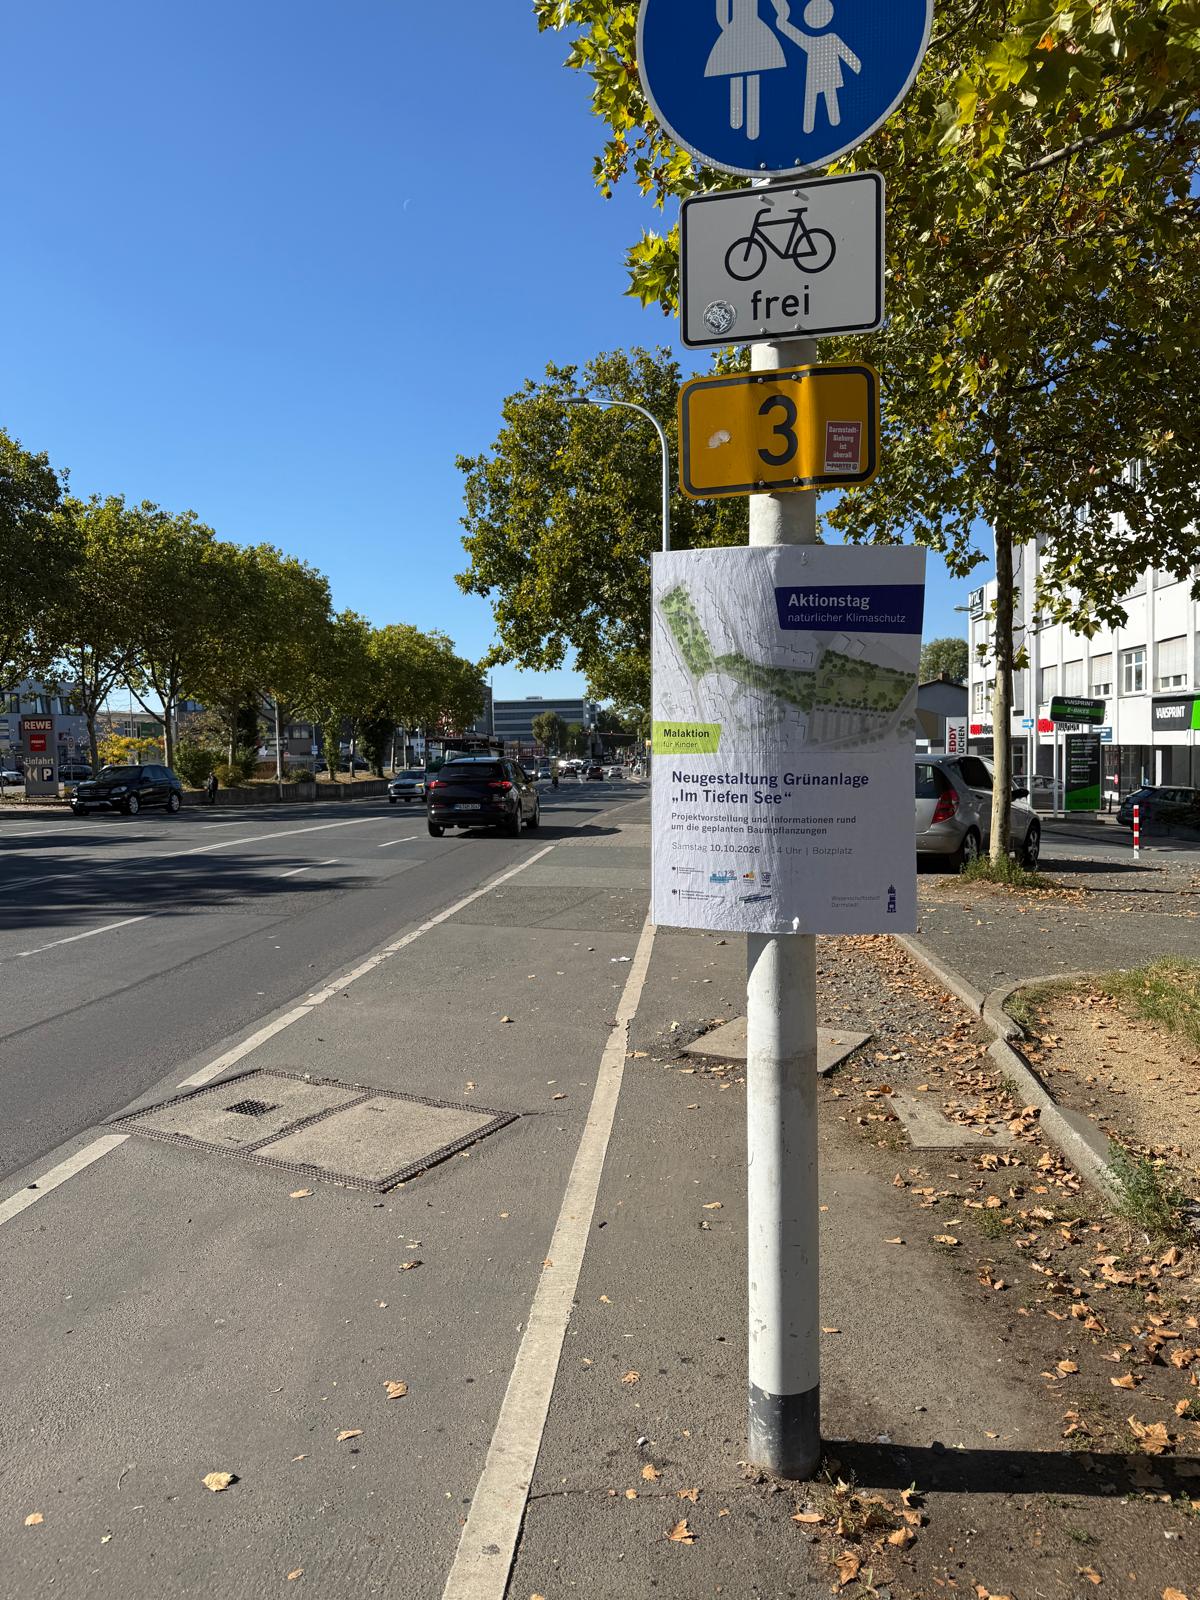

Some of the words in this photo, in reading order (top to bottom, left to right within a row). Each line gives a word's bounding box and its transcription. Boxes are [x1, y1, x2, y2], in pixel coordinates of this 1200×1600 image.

[751, 285, 810, 320] frei
[757, 394, 798, 466] 3
[788, 593, 870, 610] Aktionstag
[788, 612, 843, 622] natürlicher
[846, 612, 906, 623] Klimaschutz
[24, 720, 52, 730] REWE
[663, 729, 710, 738] Malaktion
[949, 726, 957, 753] EDDY
[25, 757, 54, 765] Einfahrt
[43, 768, 52, 780] P
[672, 771, 778, 788] Neugestaltung
[783, 772, 869, 788] Grünanlage
[672, 789, 697, 803] „Im
[703, 790, 748, 804] Tiefen
[754, 791, 792, 804] See“
[671, 812, 749, 825] Projektvorstellung
[751, 815, 768, 824] und
[771, 815, 834, 824] Informationen
[836, 814, 856, 824] rund
[686, 823, 699, 832] die
[702, 825, 744, 834] geplanten
[748, 825, 827, 836] Baumpflanzungen
[671, 842, 707, 853] Samstag
[710, 843, 760, 854] 10.10.2026
[812, 847, 853, 857] Bolzplatz
